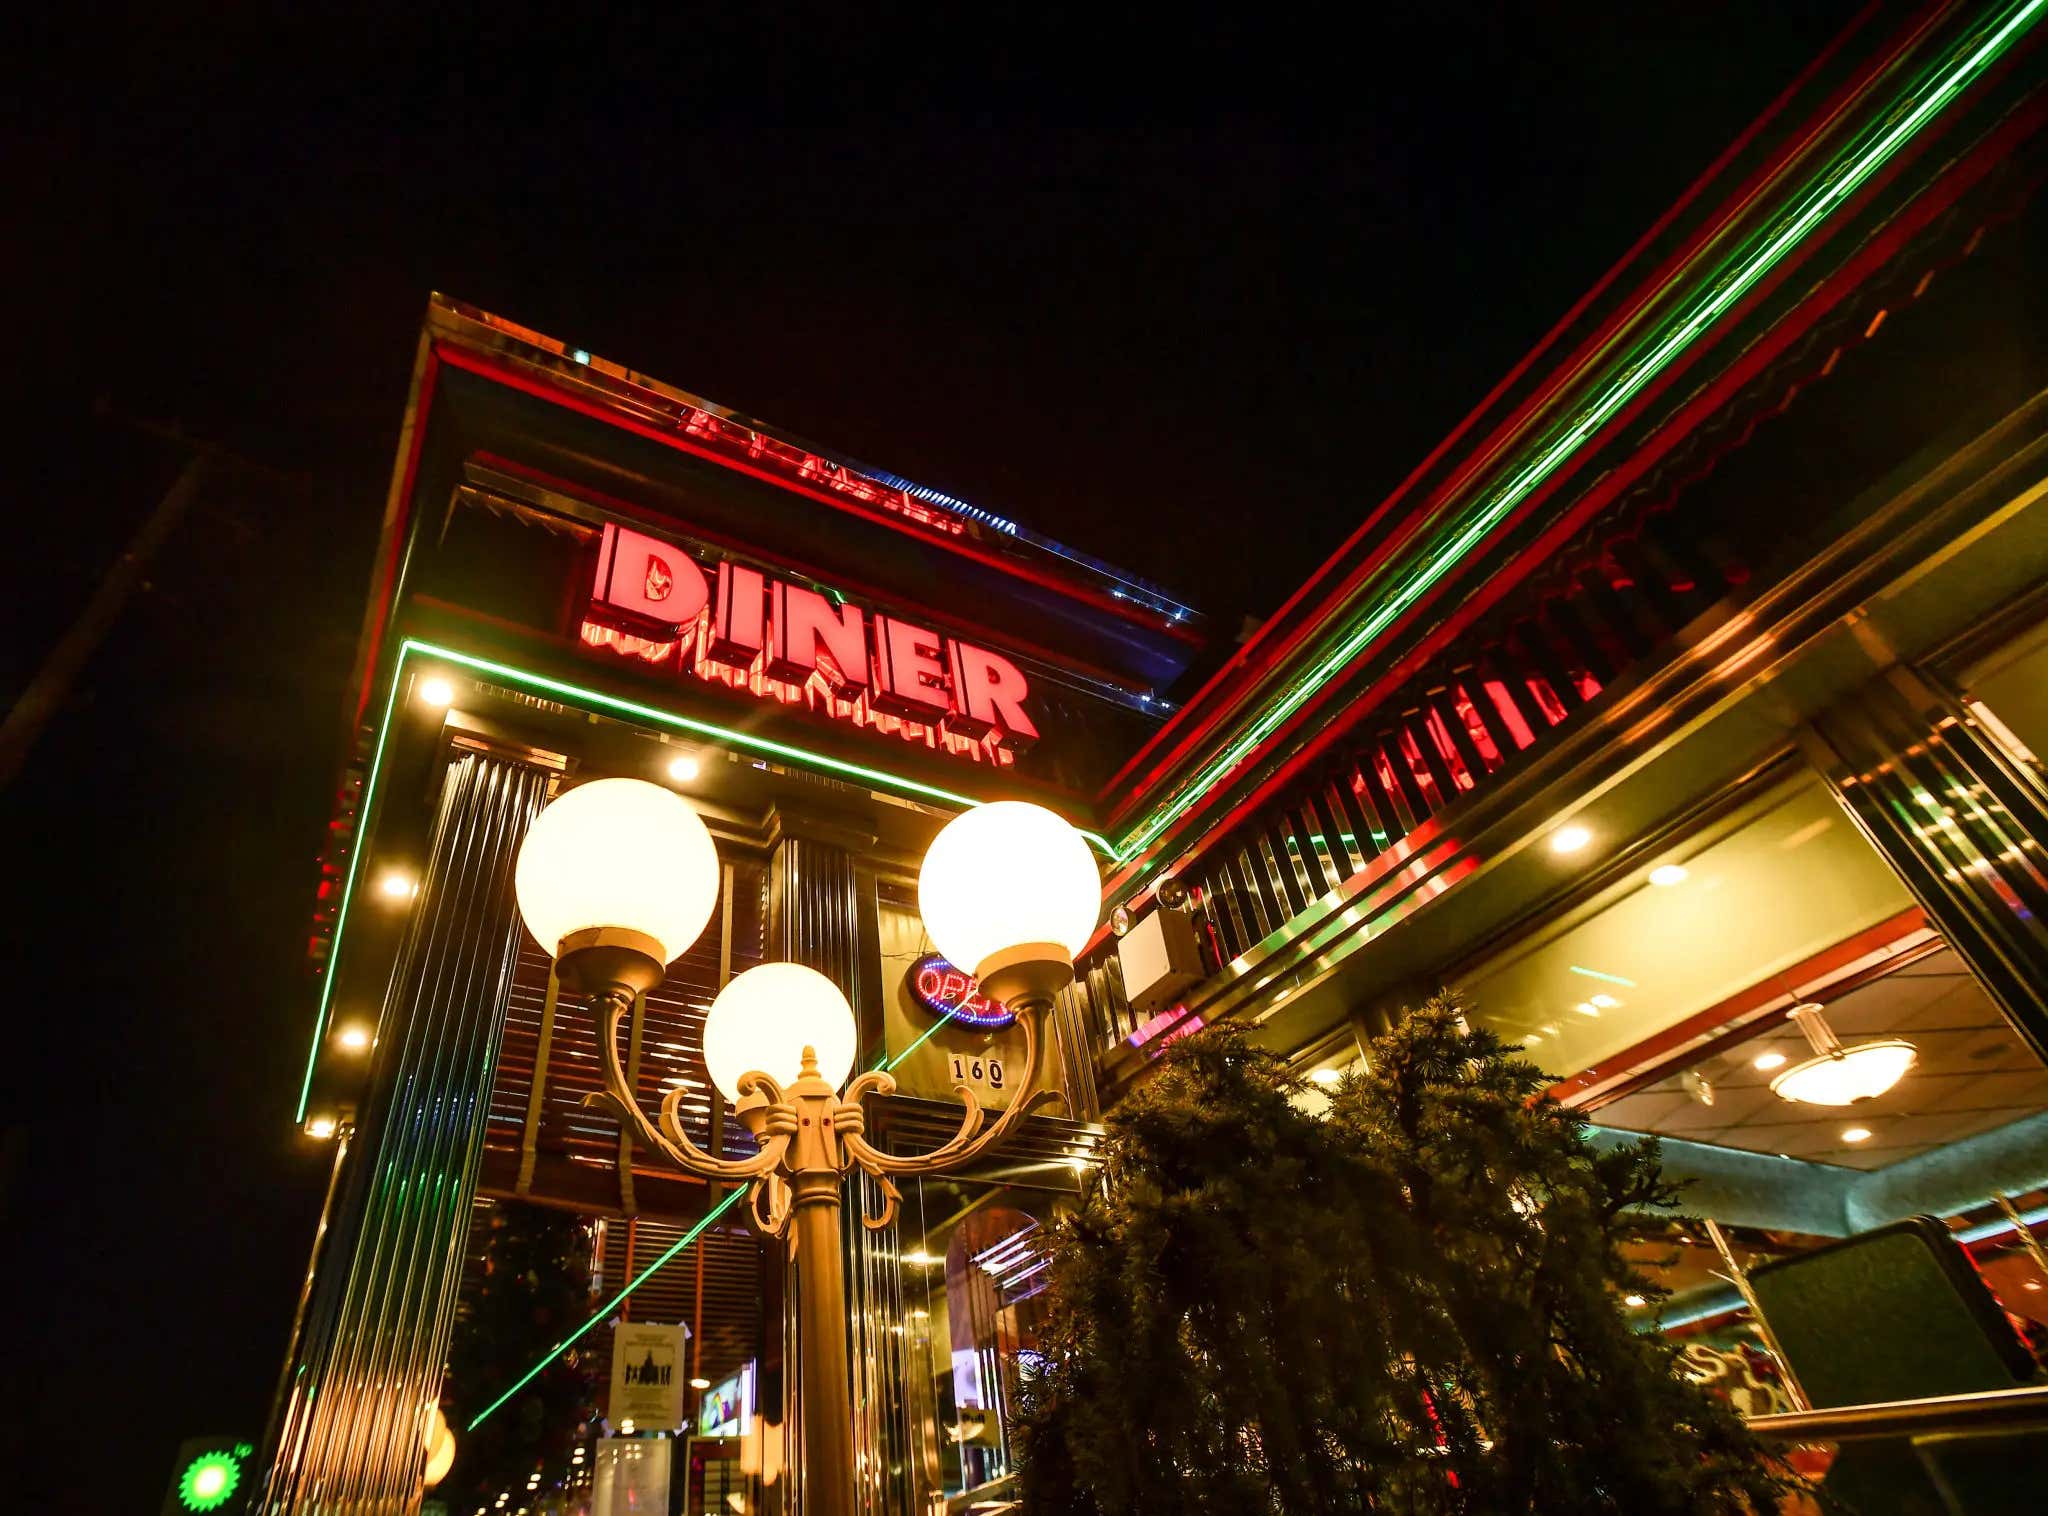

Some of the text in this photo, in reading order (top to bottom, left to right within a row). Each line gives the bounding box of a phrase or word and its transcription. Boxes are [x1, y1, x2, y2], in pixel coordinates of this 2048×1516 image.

[591, 522, 1040, 742] DINER
[919, 969, 1008, 1015] OPE
[954, 1060, 1002, 1082] 160
